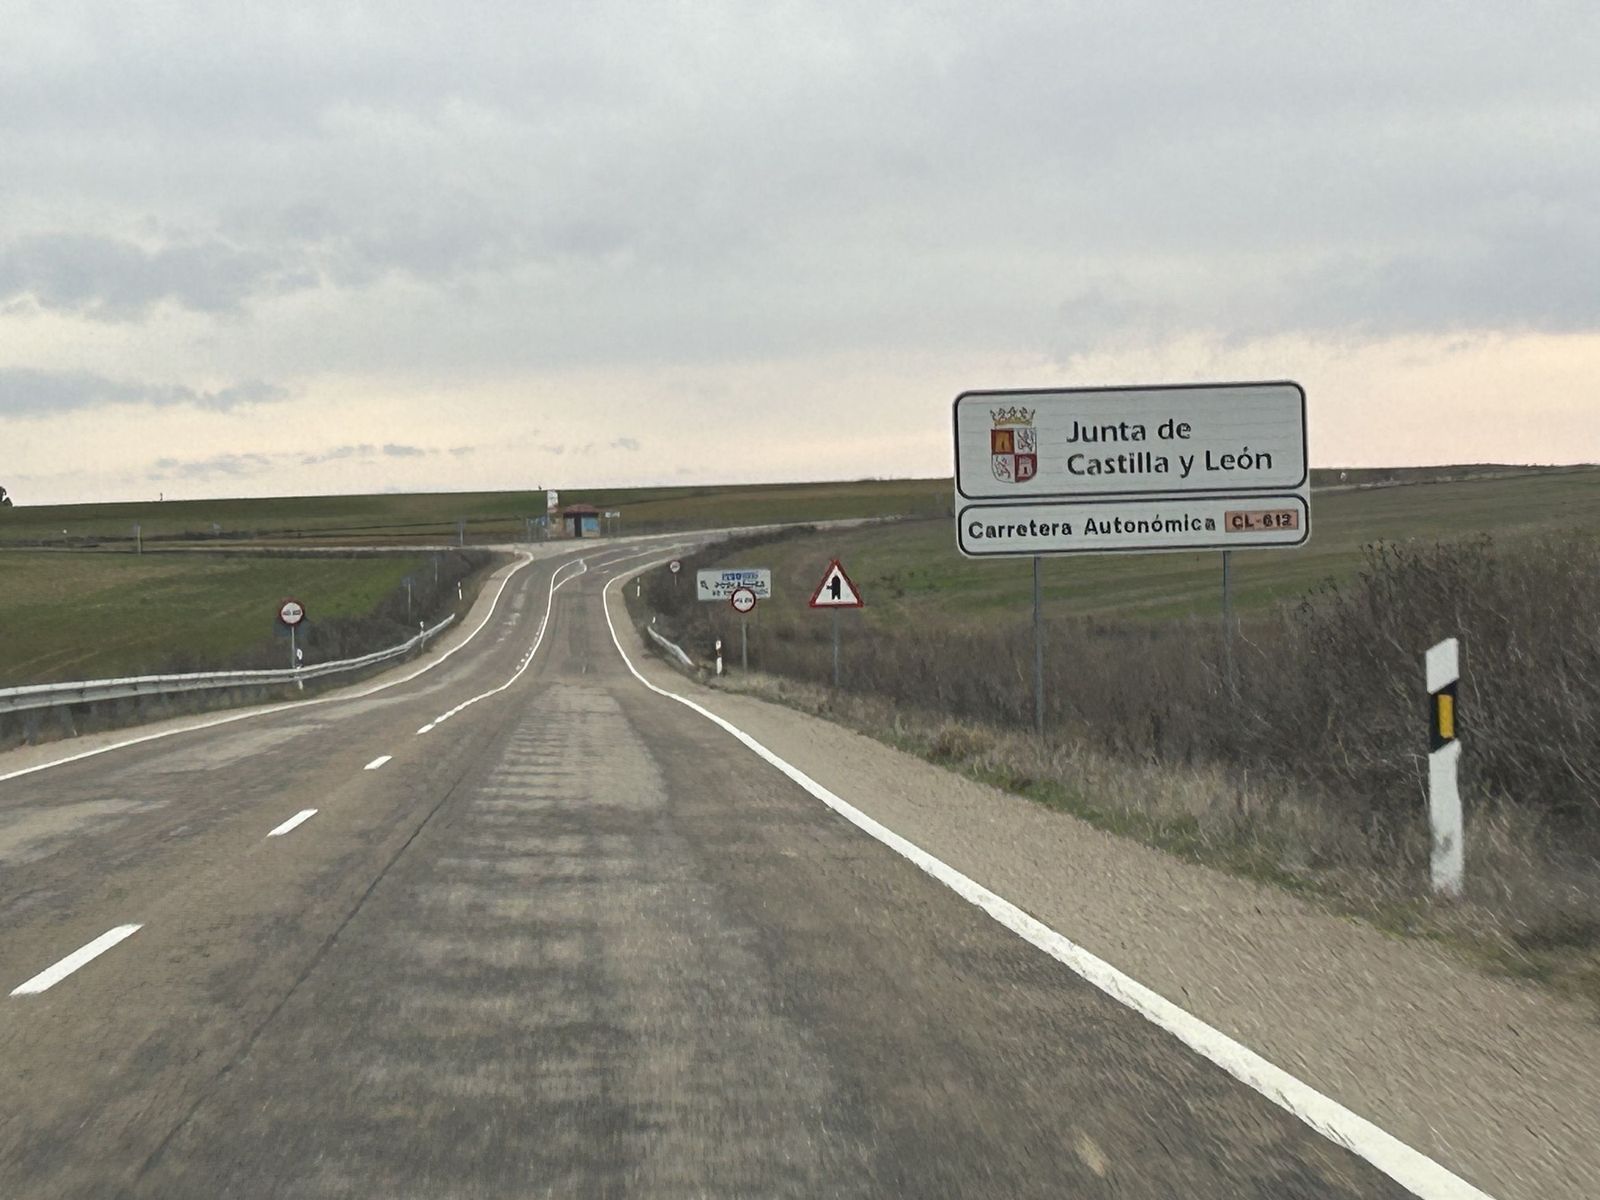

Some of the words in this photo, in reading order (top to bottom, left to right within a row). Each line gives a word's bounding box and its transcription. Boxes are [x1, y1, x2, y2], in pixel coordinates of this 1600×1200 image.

[1066, 420, 1146, 443] Junta
[1157, 418, 1192, 440] de
[1066, 451, 1169, 476] Castilla
[1179, 454, 1195, 479] y
[1205, 445, 1273, 472] León
[968, 519, 1073, 540] Carretera
[1084, 513, 1217, 536] Autonómica
